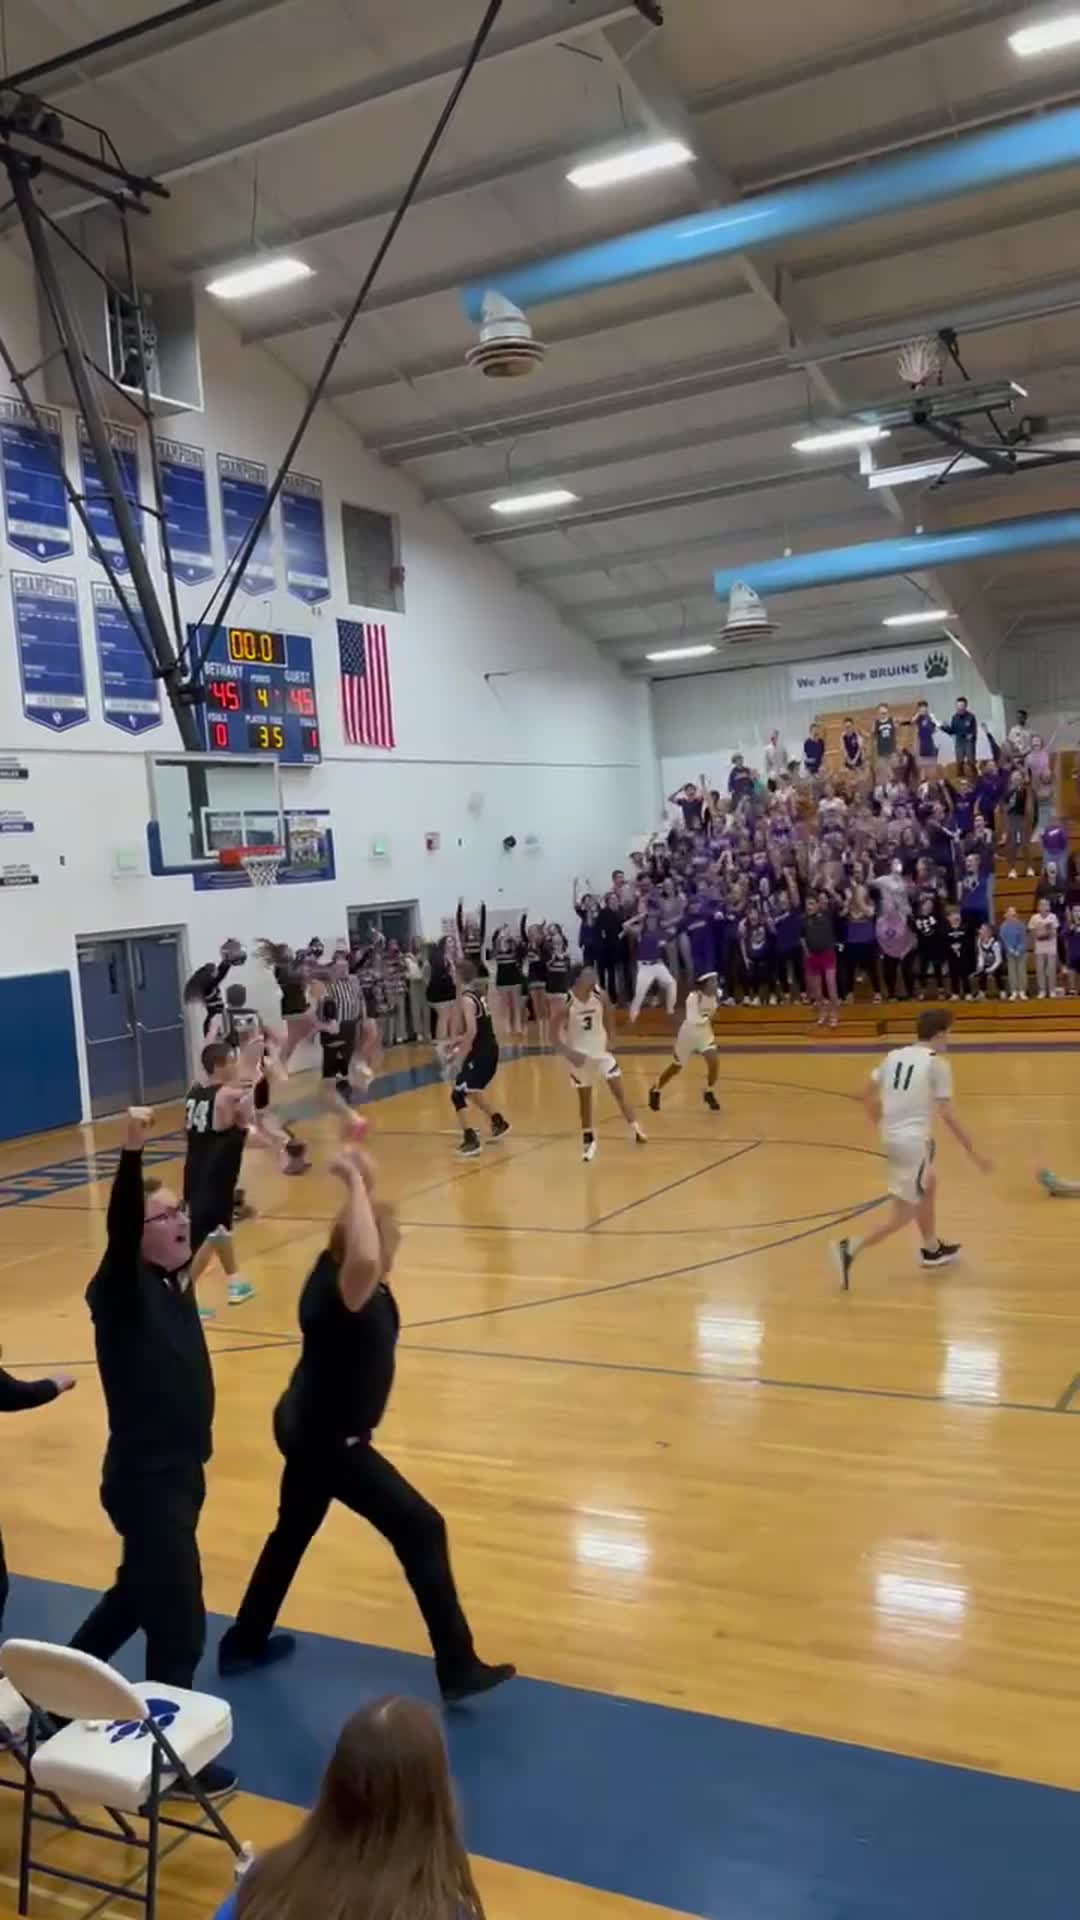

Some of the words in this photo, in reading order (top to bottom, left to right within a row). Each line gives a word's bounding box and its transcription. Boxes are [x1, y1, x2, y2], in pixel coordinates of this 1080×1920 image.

[14, 575, 76, 598] CHAMPIONS
[231, 631, 272, 661] 00.0
[204, 662, 243, 678] BETHANY
[284, 669, 311, 683] GUEST
[797, 677, 816, 689] We
[819, 675, 840, 686] Are
[842, 671, 866, 683] The
[869, 663, 919, 680] BRUINS
[257, 688, 268, 708] 4
[289, 687, 315, 715] 45
[215, 723, 228, 748] 0
[583, 1016, 593, 1031] 3
[893, 1061, 915, 1092] 11
